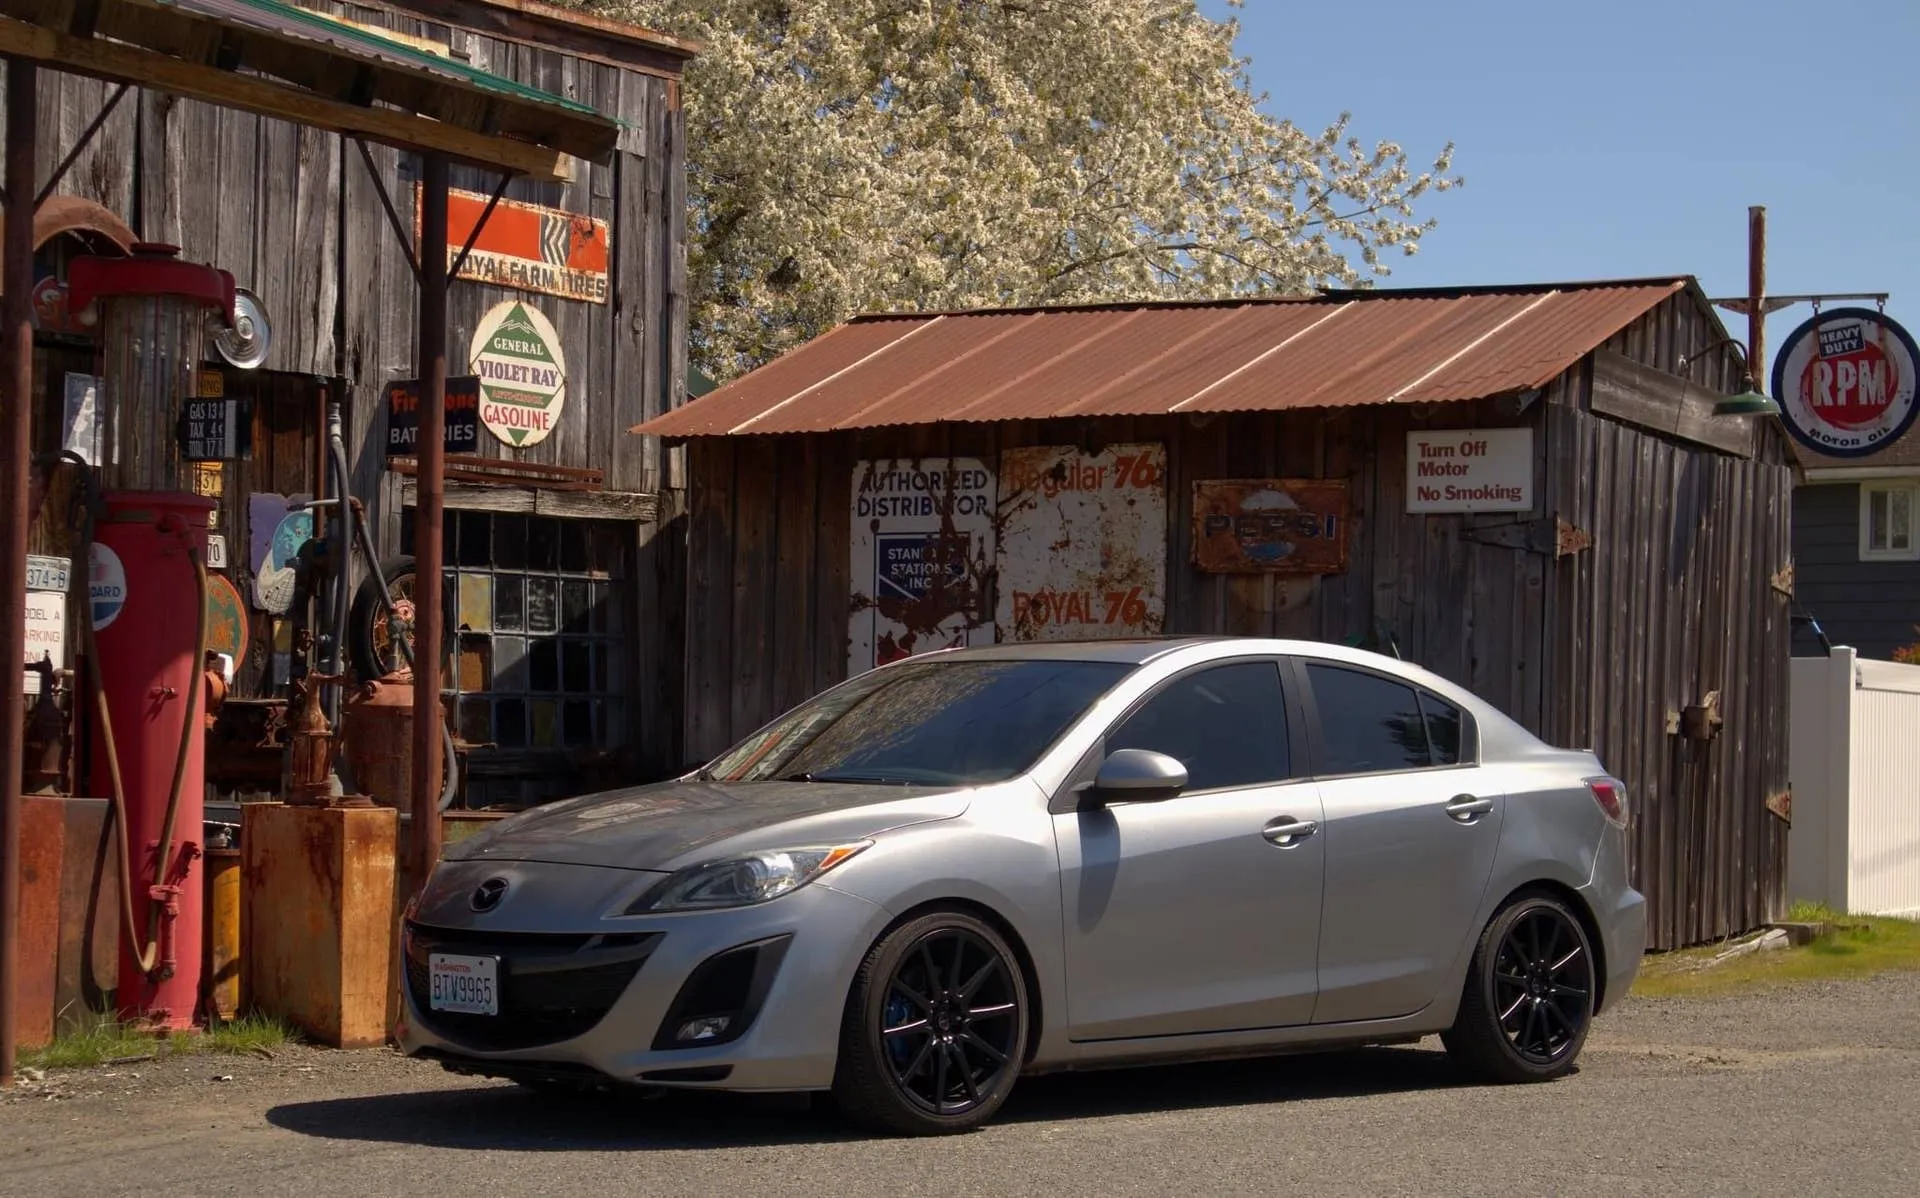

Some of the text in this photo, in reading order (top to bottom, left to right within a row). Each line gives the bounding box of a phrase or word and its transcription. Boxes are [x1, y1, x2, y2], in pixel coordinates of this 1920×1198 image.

[560, 270, 606, 297] TIRES
[1821, 326, 1860, 343] HEAVY
[493, 337, 544, 356] GENERAL
[1824, 339, 1858, 354] DUTY
[478, 359, 558, 388] VIOLET RAY
[1813, 359, 1887, 407] RPM
[189, 403, 206, 419] GAS
[391, 389, 477, 415] Firone
[483, 404, 550, 431] GASOLINE
[189, 422, 205, 438] TAX
[390, 424, 474, 444] BATIES
[1809, 427, 1891, 447] MOTOR OIL
[1418, 440, 1488, 458] Turn Off
[1008, 451, 1156, 498] Regular 76
[1418, 461, 1470, 477] Motor
[1417, 484, 1522, 502] No Smoking
[54, 610, 60, 621] A
[1013, 586, 1146, 628] ROYAL 76
[24, 629, 61, 643] ARKING
[433, 974, 492, 1004] BTV9965
